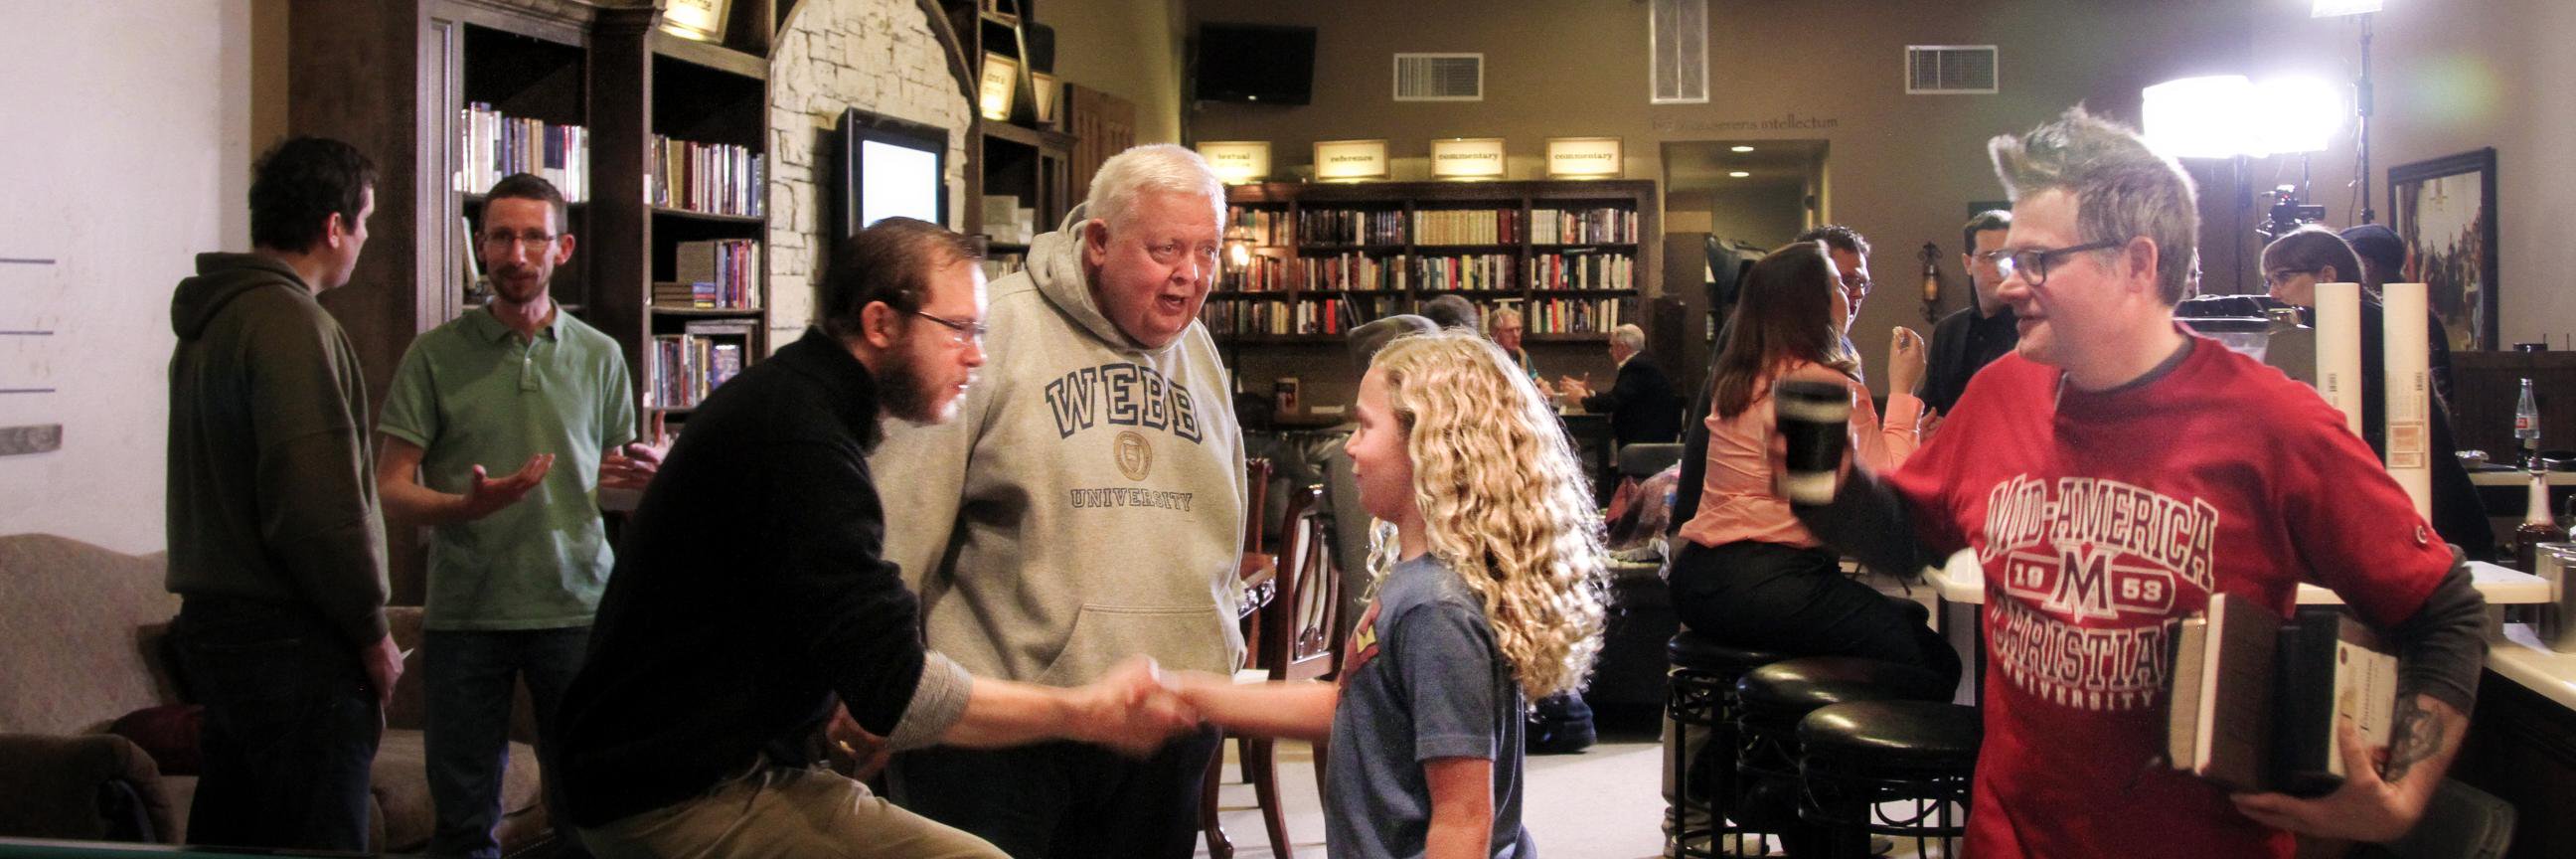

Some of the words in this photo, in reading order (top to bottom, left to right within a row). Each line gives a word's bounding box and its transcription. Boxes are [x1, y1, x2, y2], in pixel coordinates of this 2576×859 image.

[1761, 113, 1839, 129] intellectum
[1438, 152, 1499, 162] commentary
[1554, 152, 1613, 162] commentary
[1045, 362, 1204, 445] WEBB
[1070, 487, 1193, 512] UNIVERSITY
[1981, 472, 2219, 595] MID-AMERICA
[2012, 563, 2044, 588] 19
[2041, 542, 2119, 623] M
[2122, 577, 2164, 602] 53
[1990, 597, 2179, 692] CHRISTIA
[2003, 656, 2155, 711] UNIVERSITY
